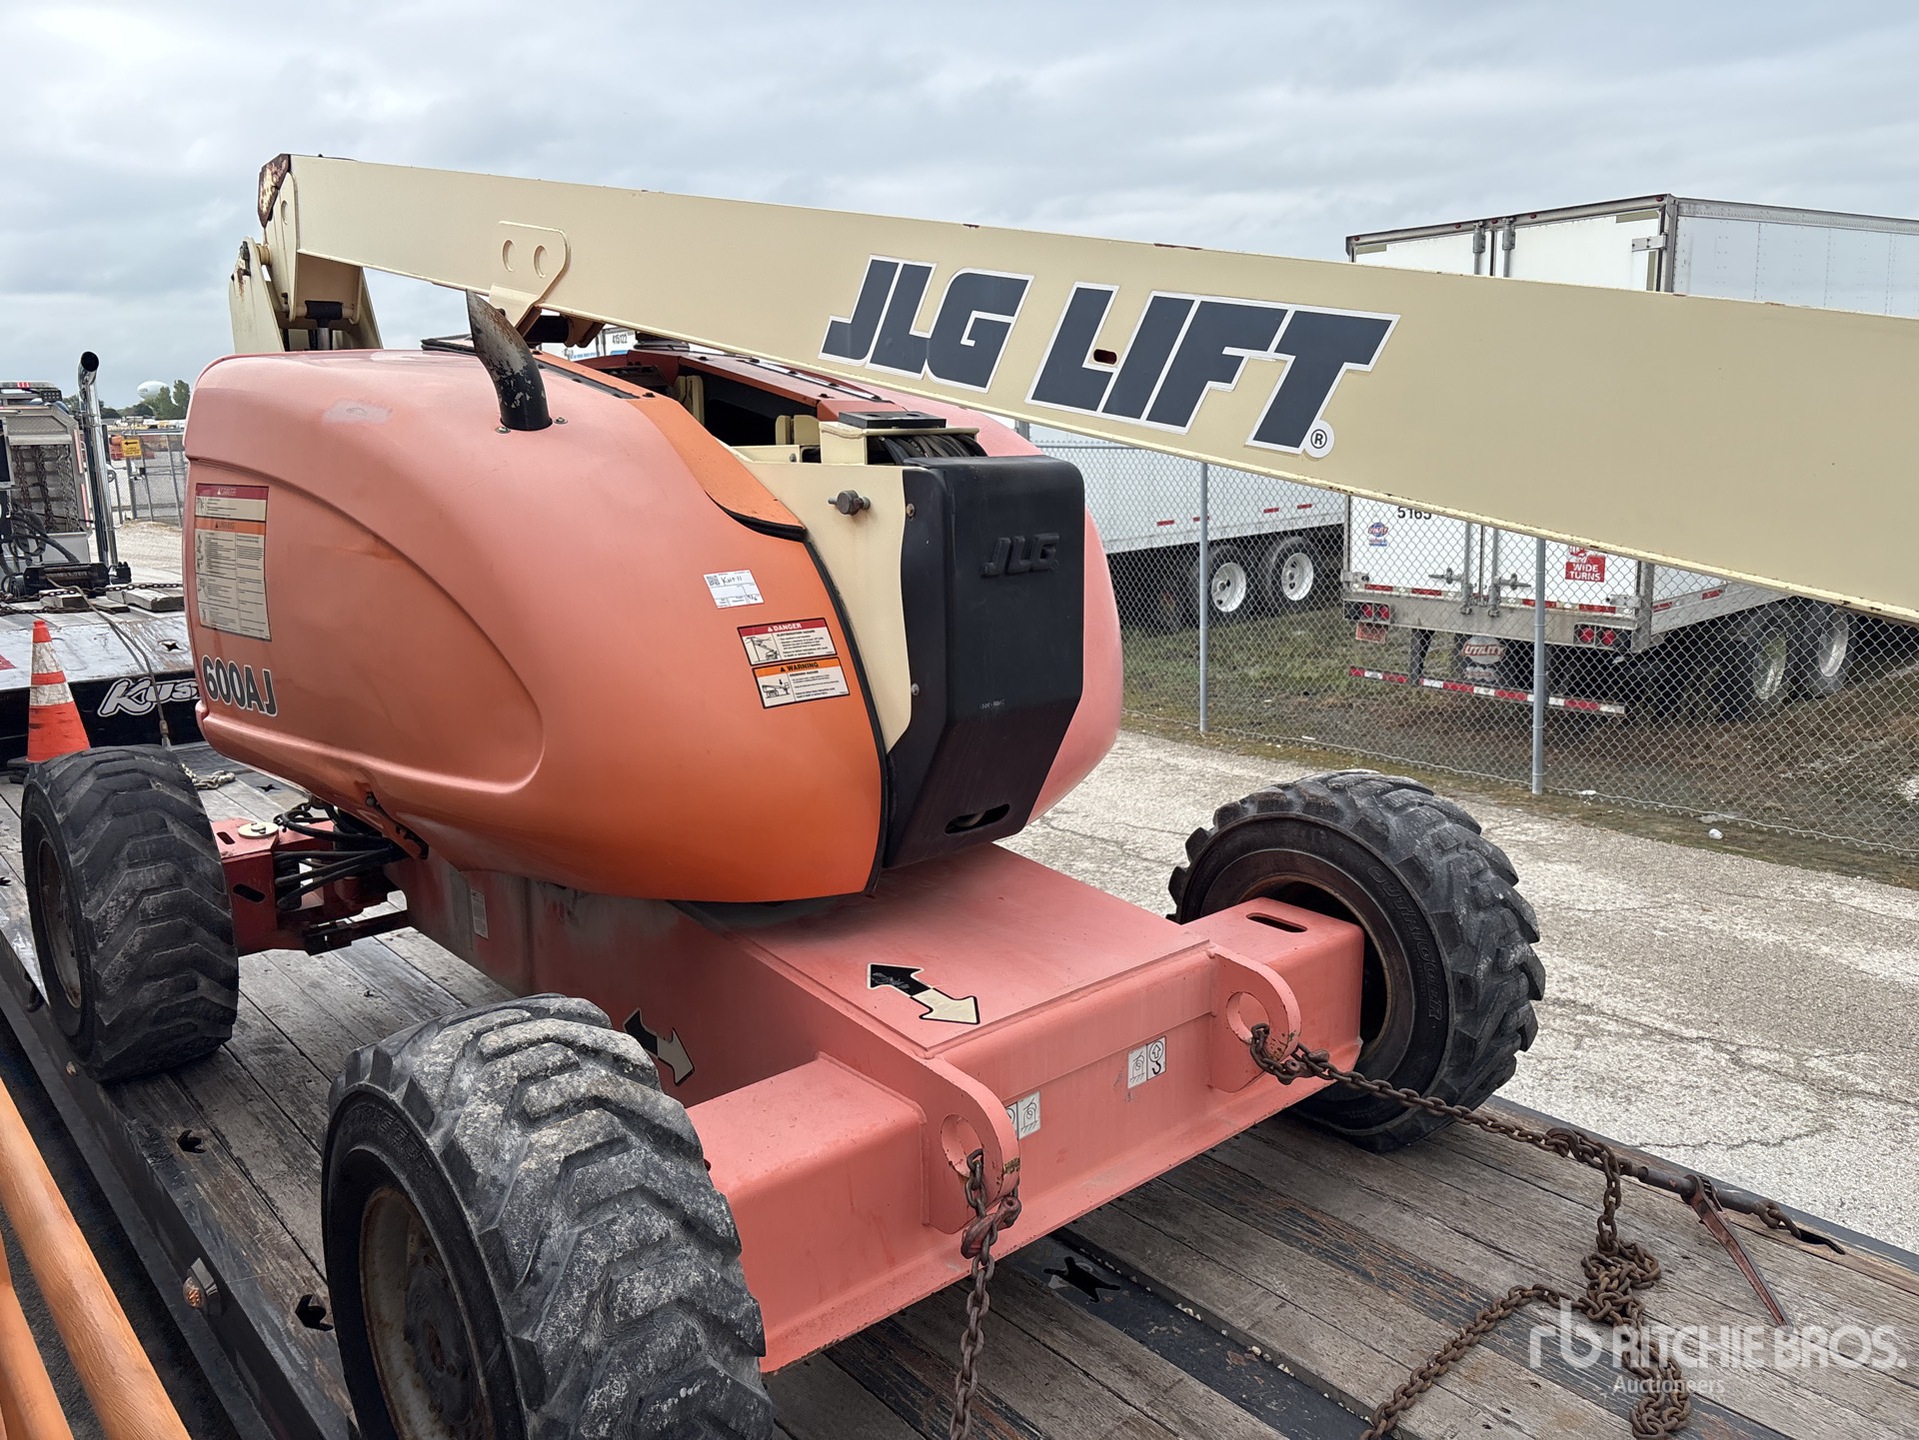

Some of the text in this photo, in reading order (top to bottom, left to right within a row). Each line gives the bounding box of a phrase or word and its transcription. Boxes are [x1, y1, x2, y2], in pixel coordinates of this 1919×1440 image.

[819, 255, 1034, 393] JLG
[1027, 282, 1400, 454] LIFT
[981, 533, 1060, 578] JLG
[1573, 563, 1599, 573] WIDE
[1569, 571, 1601, 581] TURNS
[773, 622, 803, 632] DANGER
[1464, 644, 1503, 656] UTILITY
[787, 661, 819, 672] WARNING
[202, 655, 277, 716] 600AJ
[1368, 866, 1443, 1021] OUTRIGGER
